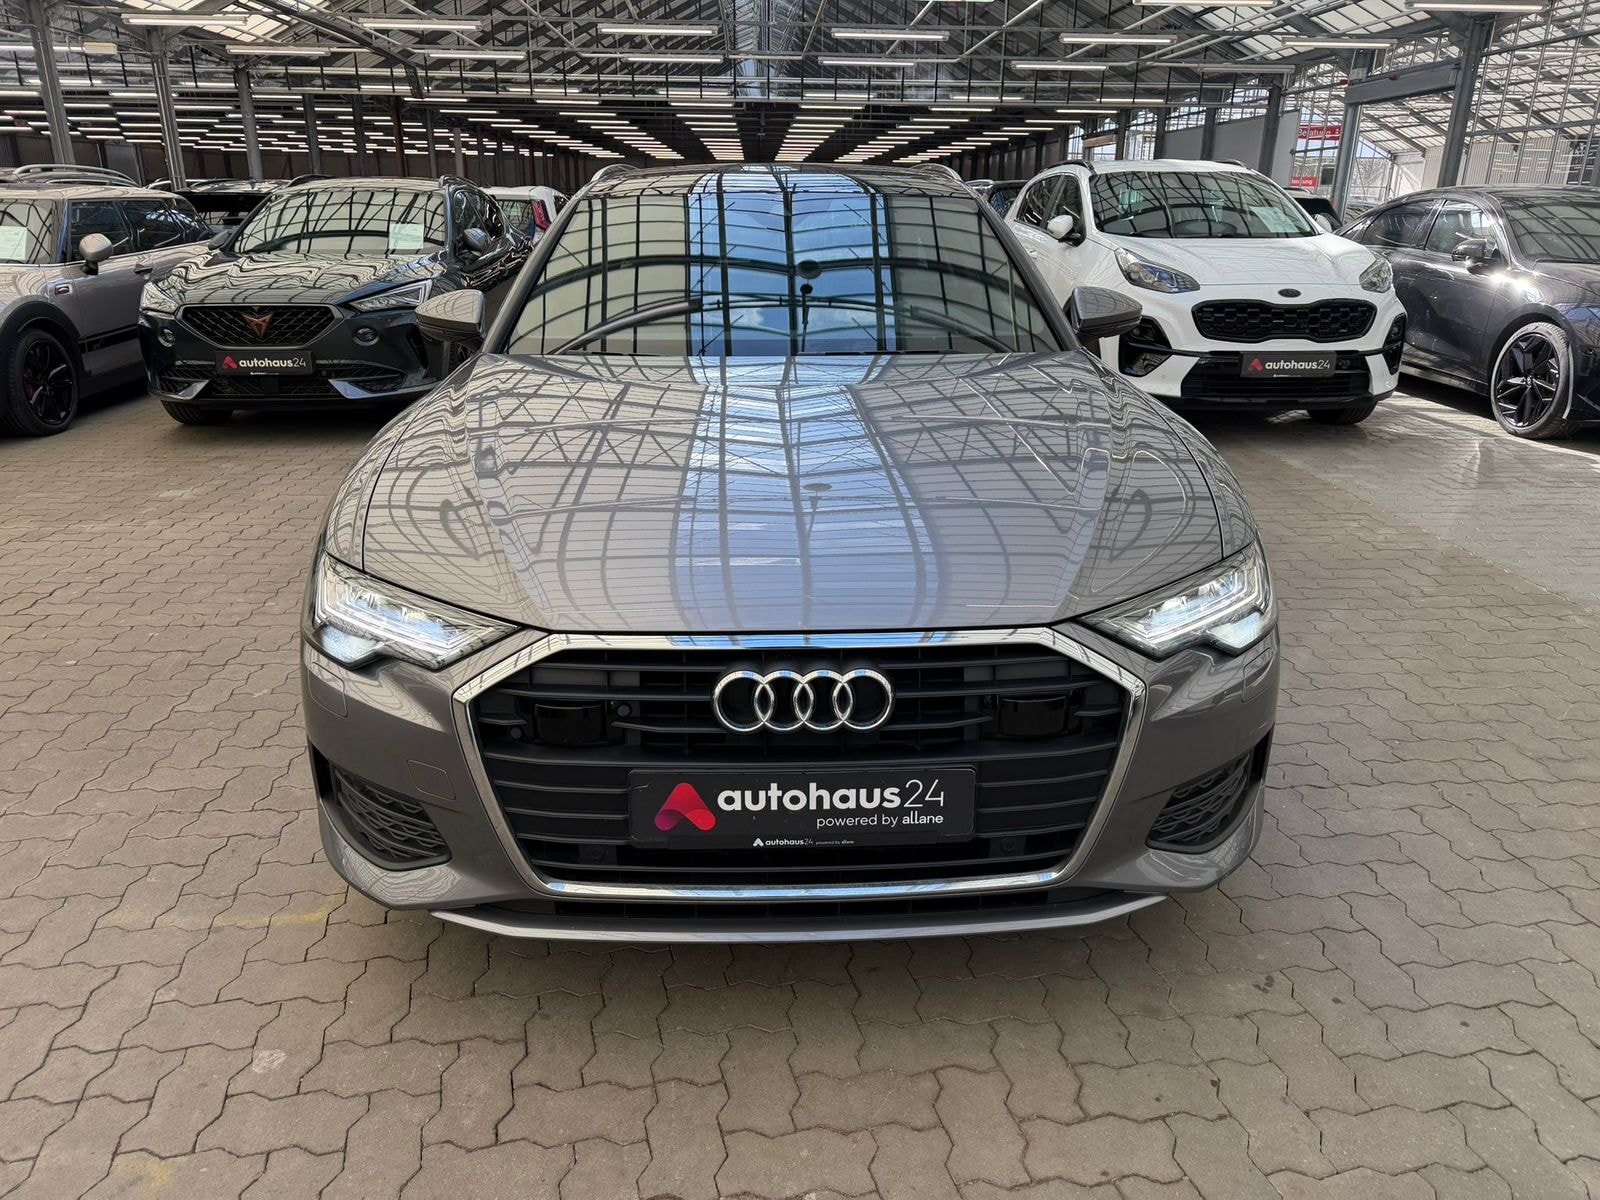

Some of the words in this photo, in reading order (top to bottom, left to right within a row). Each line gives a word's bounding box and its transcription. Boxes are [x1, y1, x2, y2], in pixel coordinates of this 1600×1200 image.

[239, 357, 306, 367] autohaus24
[1265, 359, 1330, 369] autohaus24
[717, 779, 944, 811] autohaus24
[816, 811, 877, 829] powered
[881, 814, 899, 827] by
[902, 811, 944, 825] allane
[765, 838, 813, 846] autohaus24
